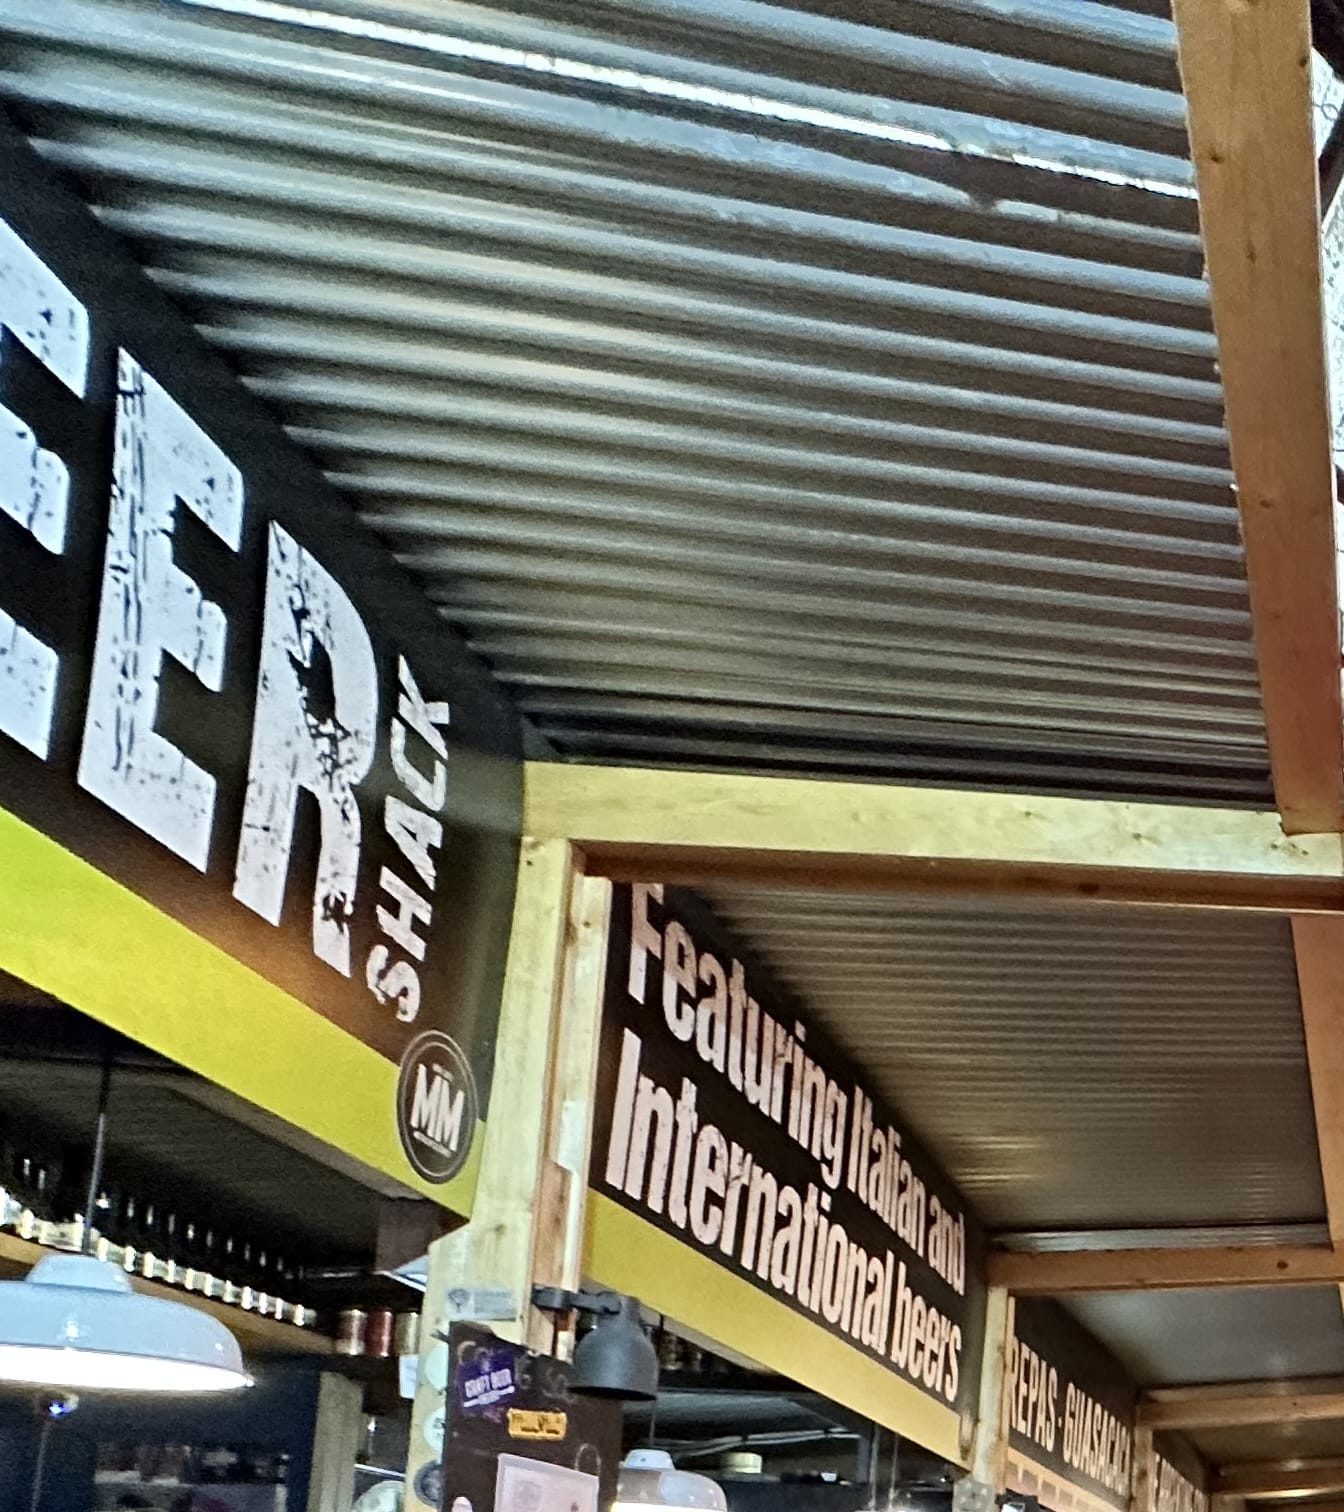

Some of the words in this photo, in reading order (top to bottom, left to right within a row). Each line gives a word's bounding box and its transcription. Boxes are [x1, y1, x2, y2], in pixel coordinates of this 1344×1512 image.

[366, 654, 454, 1024] SHACK
[604, 1027, 895, 1353] International
[891, 1252, 963, 1404] beers
[627, 881, 848, 1191] Featuring
[847, 1083, 927, 1258] Italian
[929, 1194, 966, 1297] and
